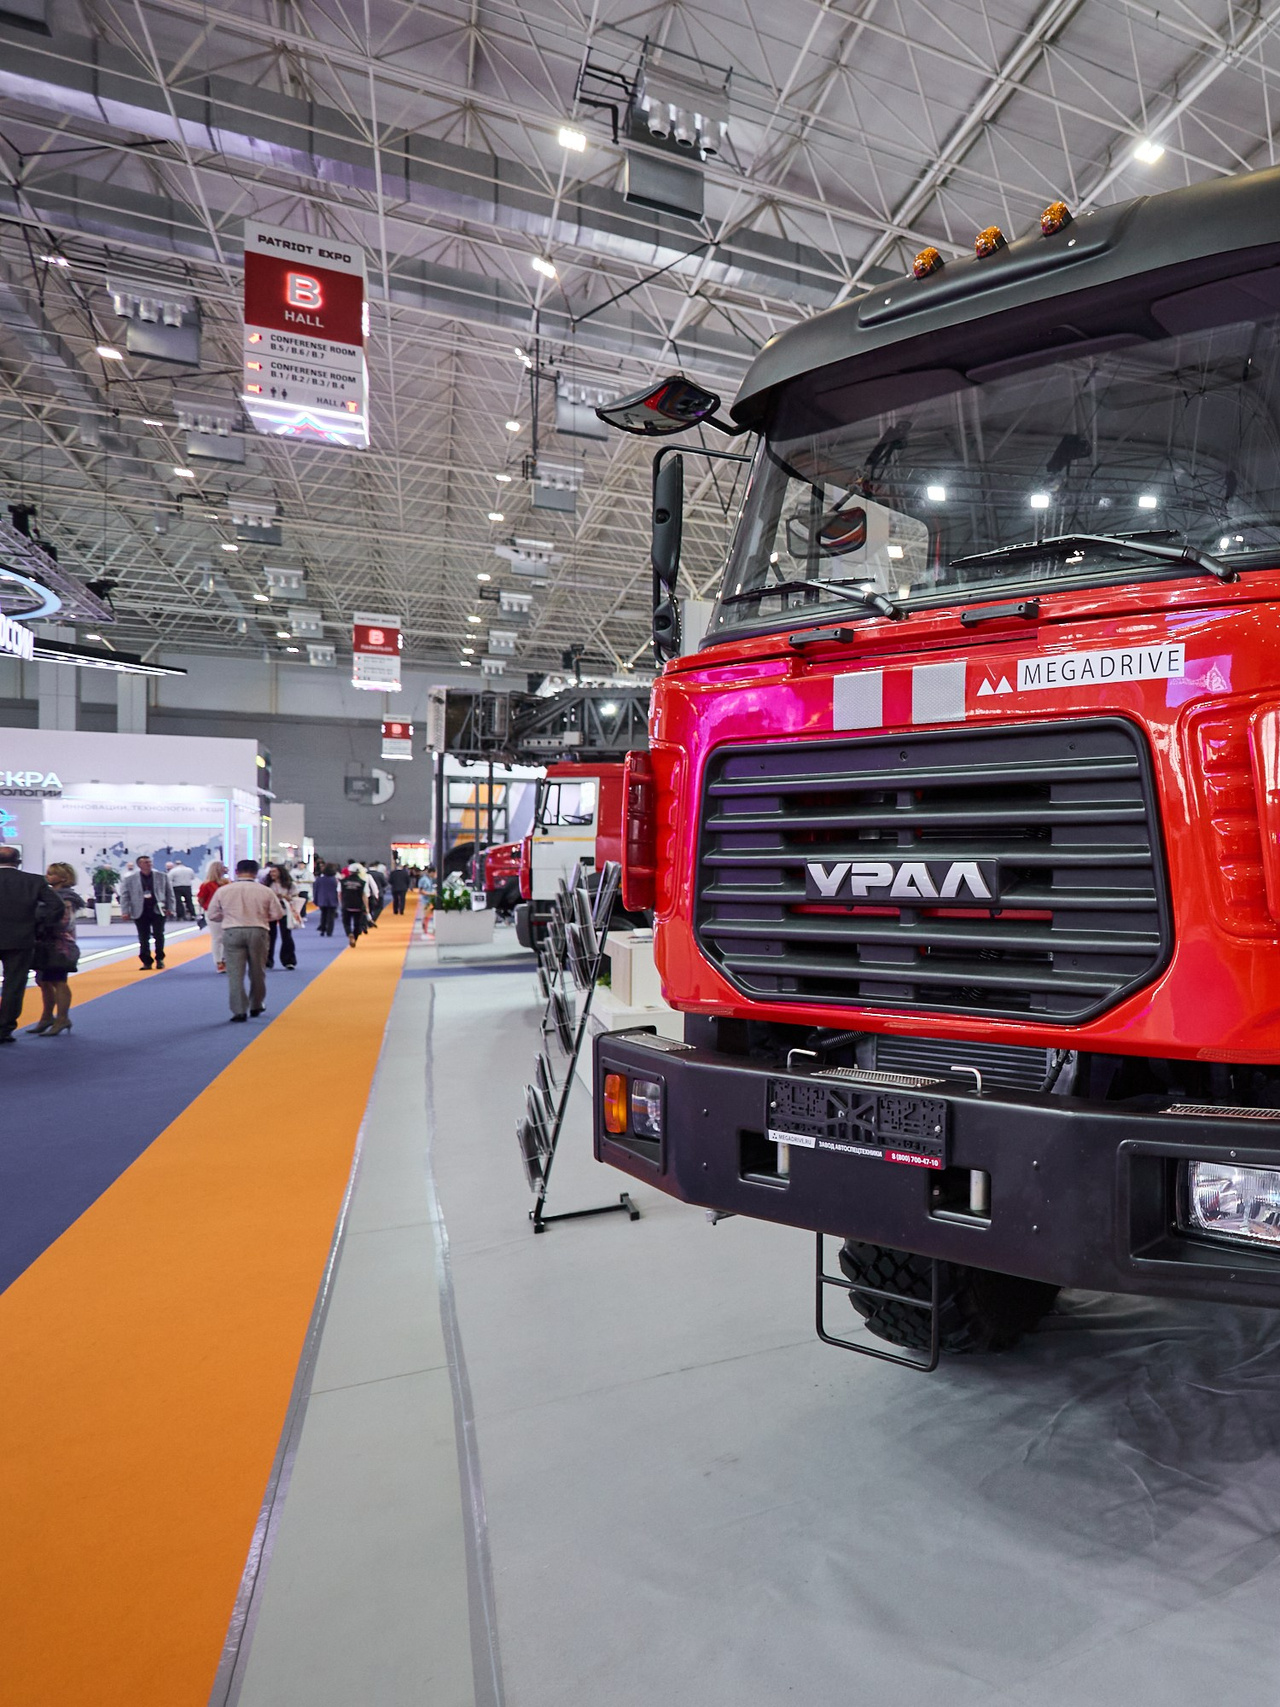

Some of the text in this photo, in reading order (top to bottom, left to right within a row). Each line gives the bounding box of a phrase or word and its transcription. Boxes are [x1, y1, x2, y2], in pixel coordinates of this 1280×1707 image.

[258, 234, 351, 263] PATRIOT EXPO
[286, 271, 323, 309] B
[284, 310, 324, 328] HALL
[270, 334, 356, 357] CONFERENSE ROOM
[270, 361, 356, 384] CONFERENSE ROOM
[317, 397, 338, 408] HALL
[1024, 650, 1180, 686] MEGADRIVE
[0, 771, 63, 788] КРА
[806, 862, 993, 898] УРАЛ
